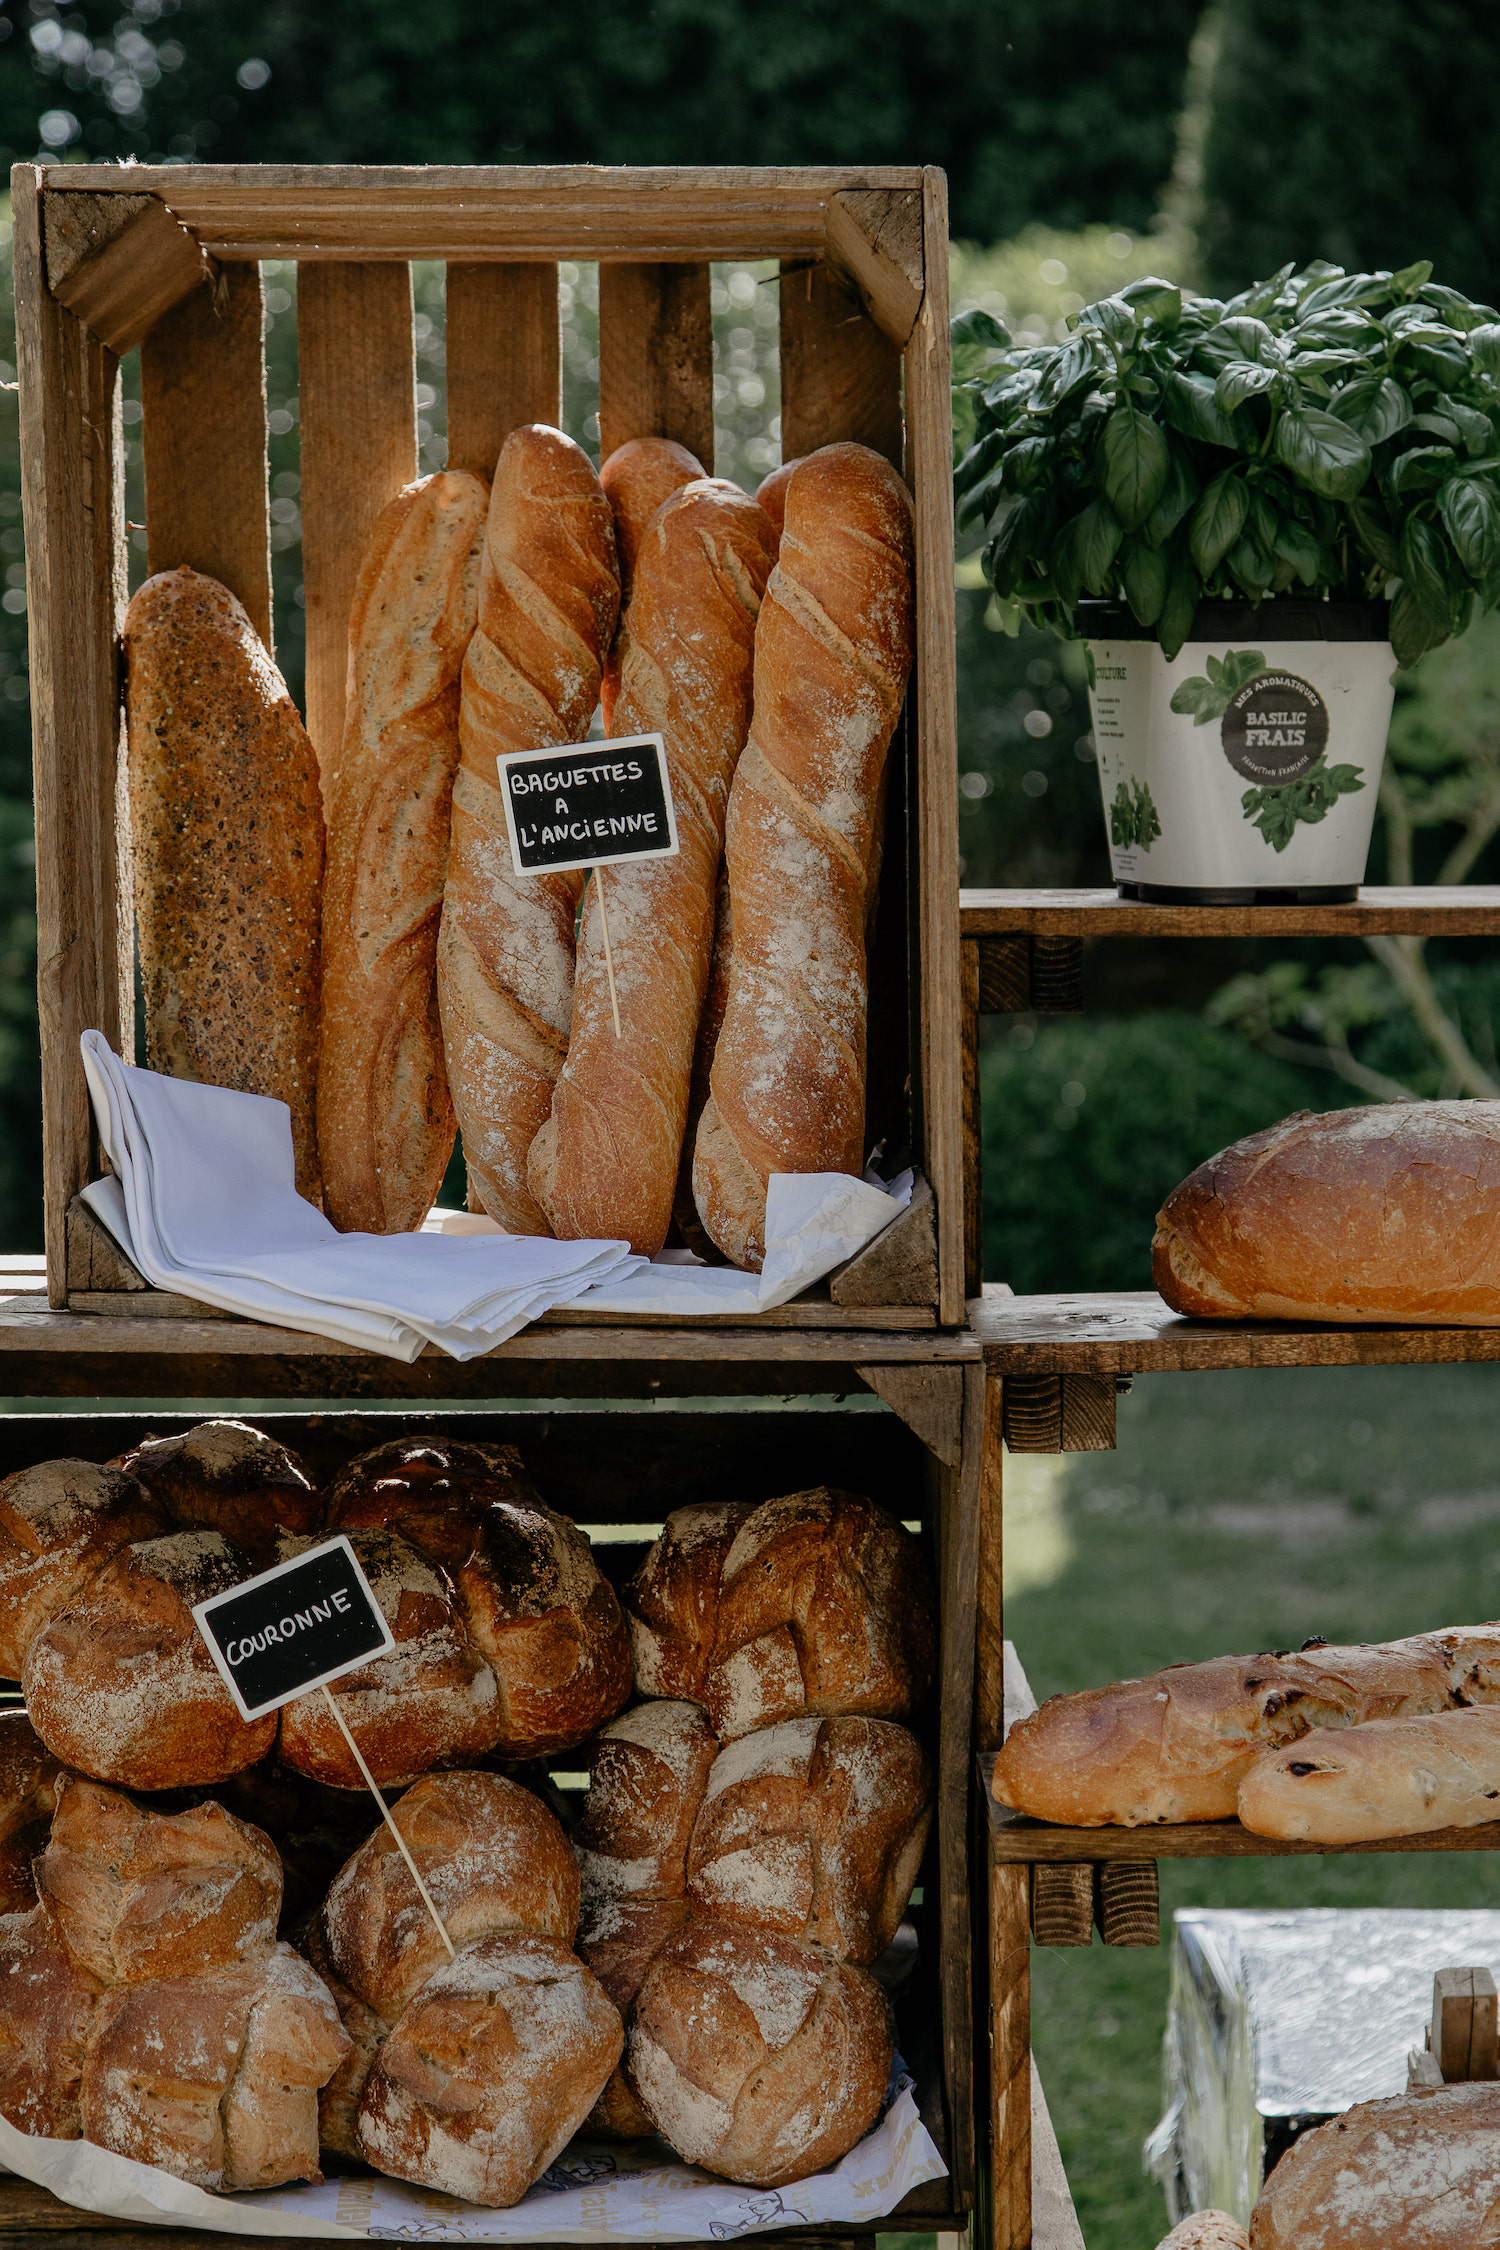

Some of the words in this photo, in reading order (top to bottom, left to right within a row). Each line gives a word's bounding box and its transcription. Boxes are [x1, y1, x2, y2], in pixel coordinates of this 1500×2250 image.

[1234, 687, 1254, 709] MES
[1255, 676, 1320, 707] AROMATIQUES
[1246, 711, 1308, 726] BASILIC
[1246, 729, 1307, 747] FRAIS
[510, 761, 643, 795] BAGUETTES
[555, 797, 570, 815] A
[226, 1588, 352, 1666] COURONNE
